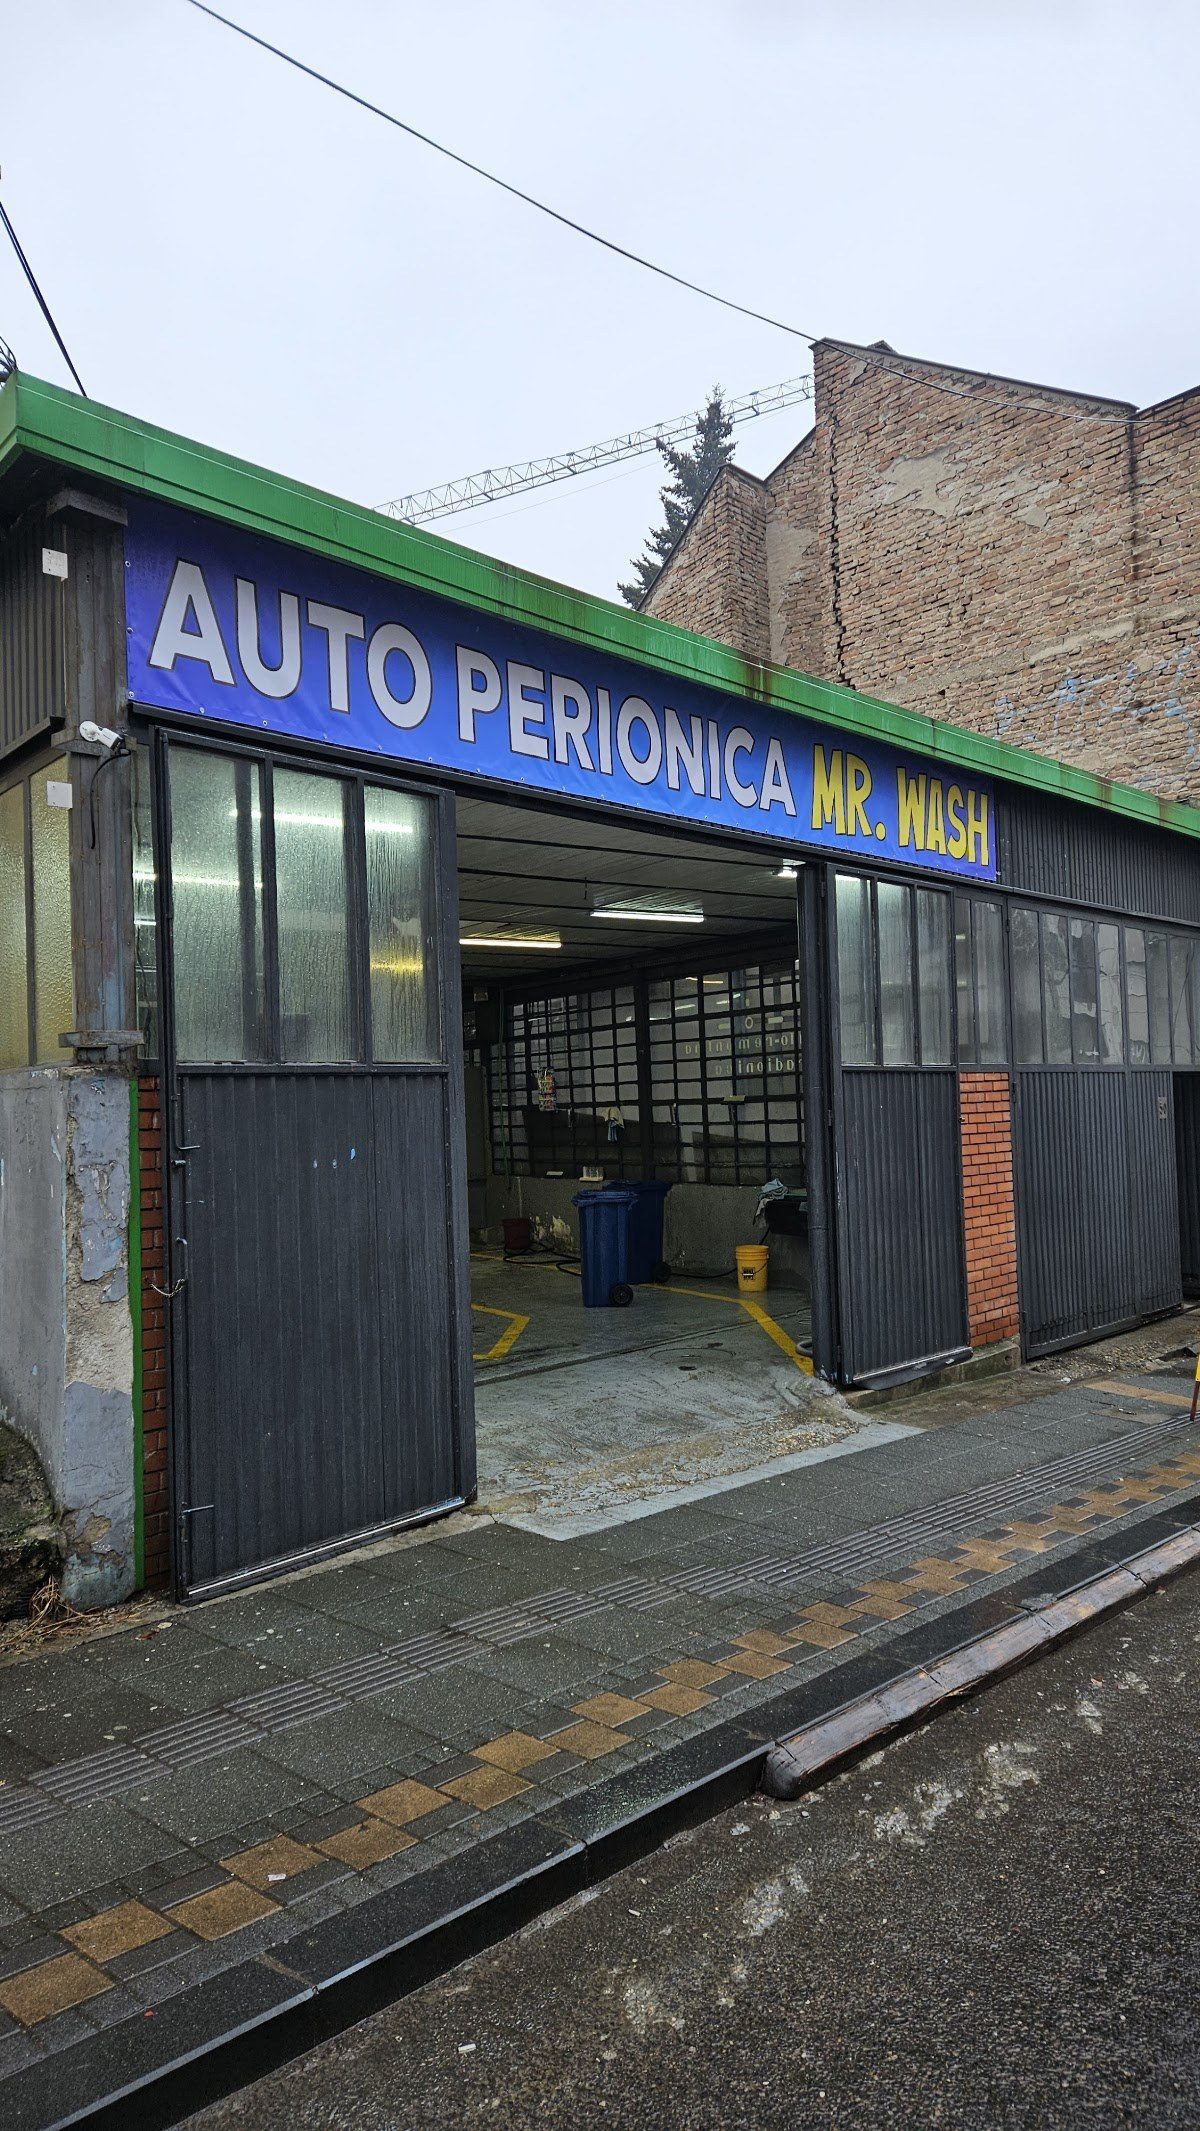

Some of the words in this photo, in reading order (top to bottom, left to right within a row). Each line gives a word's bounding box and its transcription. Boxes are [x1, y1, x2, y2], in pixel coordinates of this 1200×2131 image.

[148, 558, 432, 729] AUTO
[455, 644, 797, 817] PERIONICA
[811, 743, 886, 841] MR.
[896, 766, 989, 867] WASH
